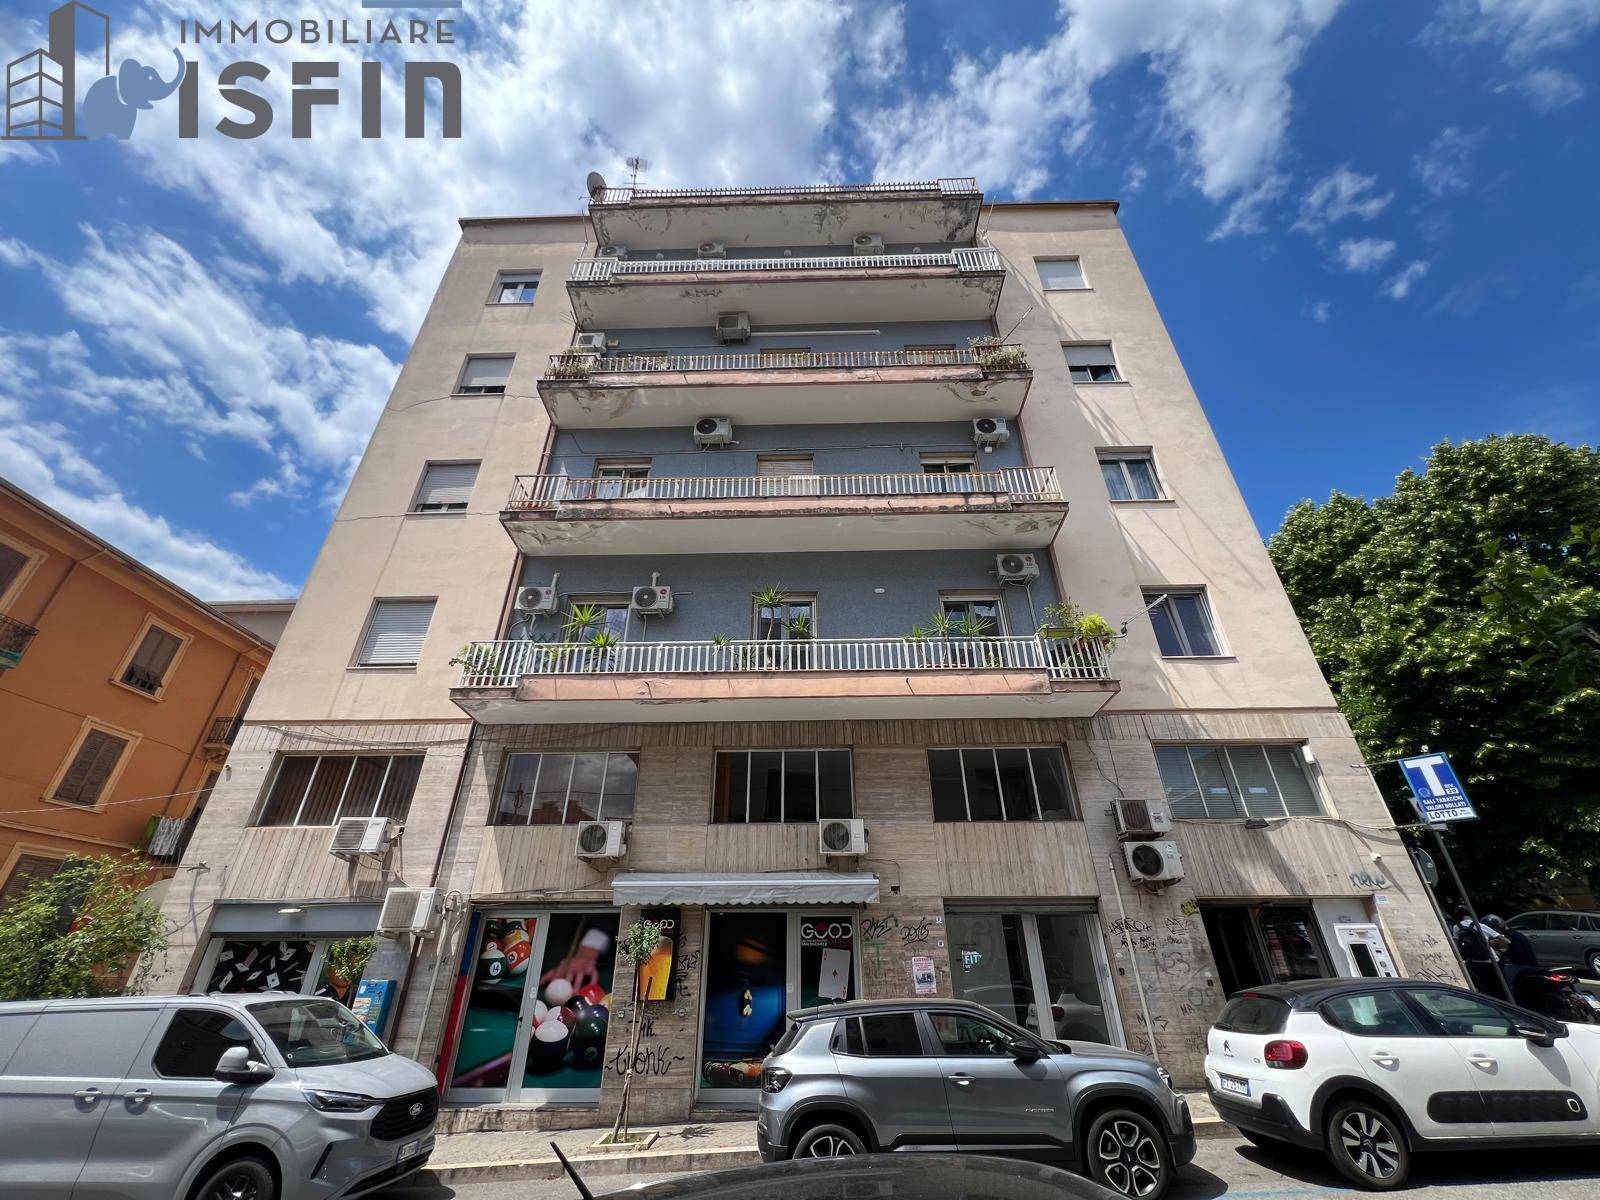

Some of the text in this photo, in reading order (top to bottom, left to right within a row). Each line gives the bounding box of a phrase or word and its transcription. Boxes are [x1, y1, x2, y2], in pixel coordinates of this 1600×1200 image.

[1404, 756, 1444, 796] T
[1425, 803, 1445, 811] VALORI
[1428, 810, 1458, 820] LOTTO
[801, 923, 853, 939] GOOD
